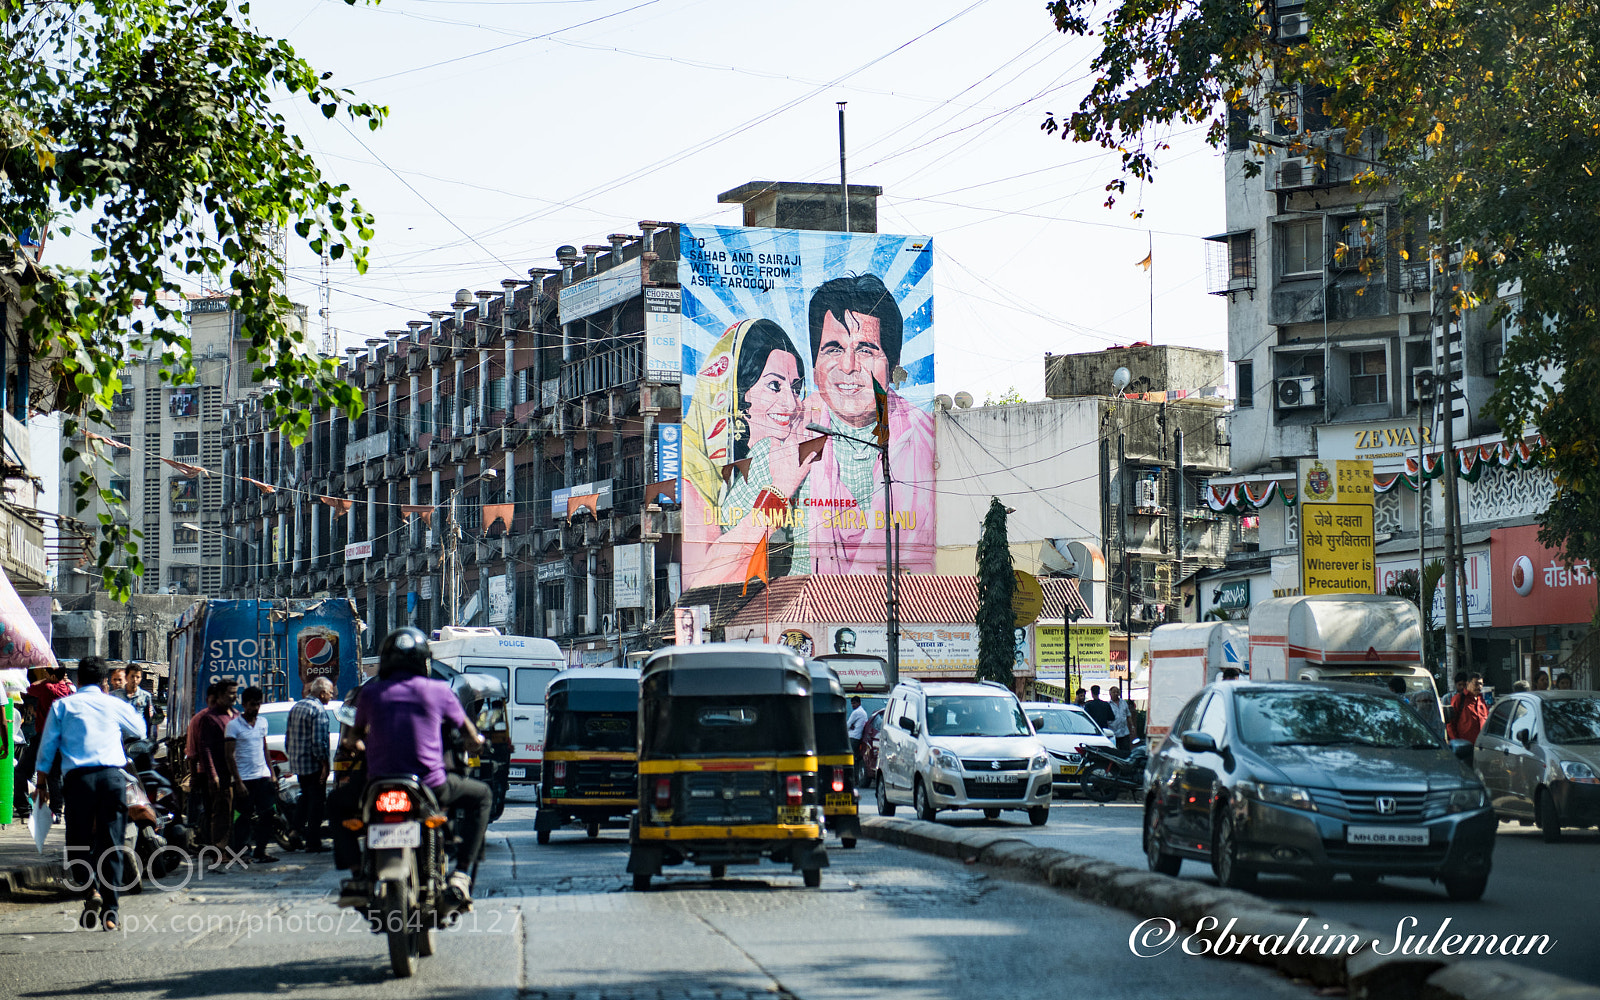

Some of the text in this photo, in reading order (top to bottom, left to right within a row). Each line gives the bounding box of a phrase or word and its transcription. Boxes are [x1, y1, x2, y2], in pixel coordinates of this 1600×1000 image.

[689, 237, 705, 249] TO
[690, 250, 801, 266] SAHAB AND SAIRAJI
[690, 263, 791, 278] WITH LOVE FROM
[691, 275, 774, 290] ASIF FAROOQUI
[647, 290, 680, 298] CHOPRA'S
[655, 314, 672, 323] I.B.
[652, 337, 675, 346] ICSE
[648, 360, 680, 370] STATE
[1354, 426, 1432, 449] ZEWAR
[663, 443, 678, 501] YAMA
[804, 498, 857, 508] CHAMBERS
[703, 506, 917, 530] DILIP KUMAR SAIRA BANU
[1314, 510, 1362, 527] जेथे दक्षता
[1306, 530, 1371, 552] तेथे सुरक्षितता
[1306, 558, 1371, 570] Wherever is
[1308, 577, 1371, 591] Precaution,
[499, 640, 525, 648] POLICE
[210, 639, 332, 676] STOP pepsi
[525, 744, 543, 752] POLICE
